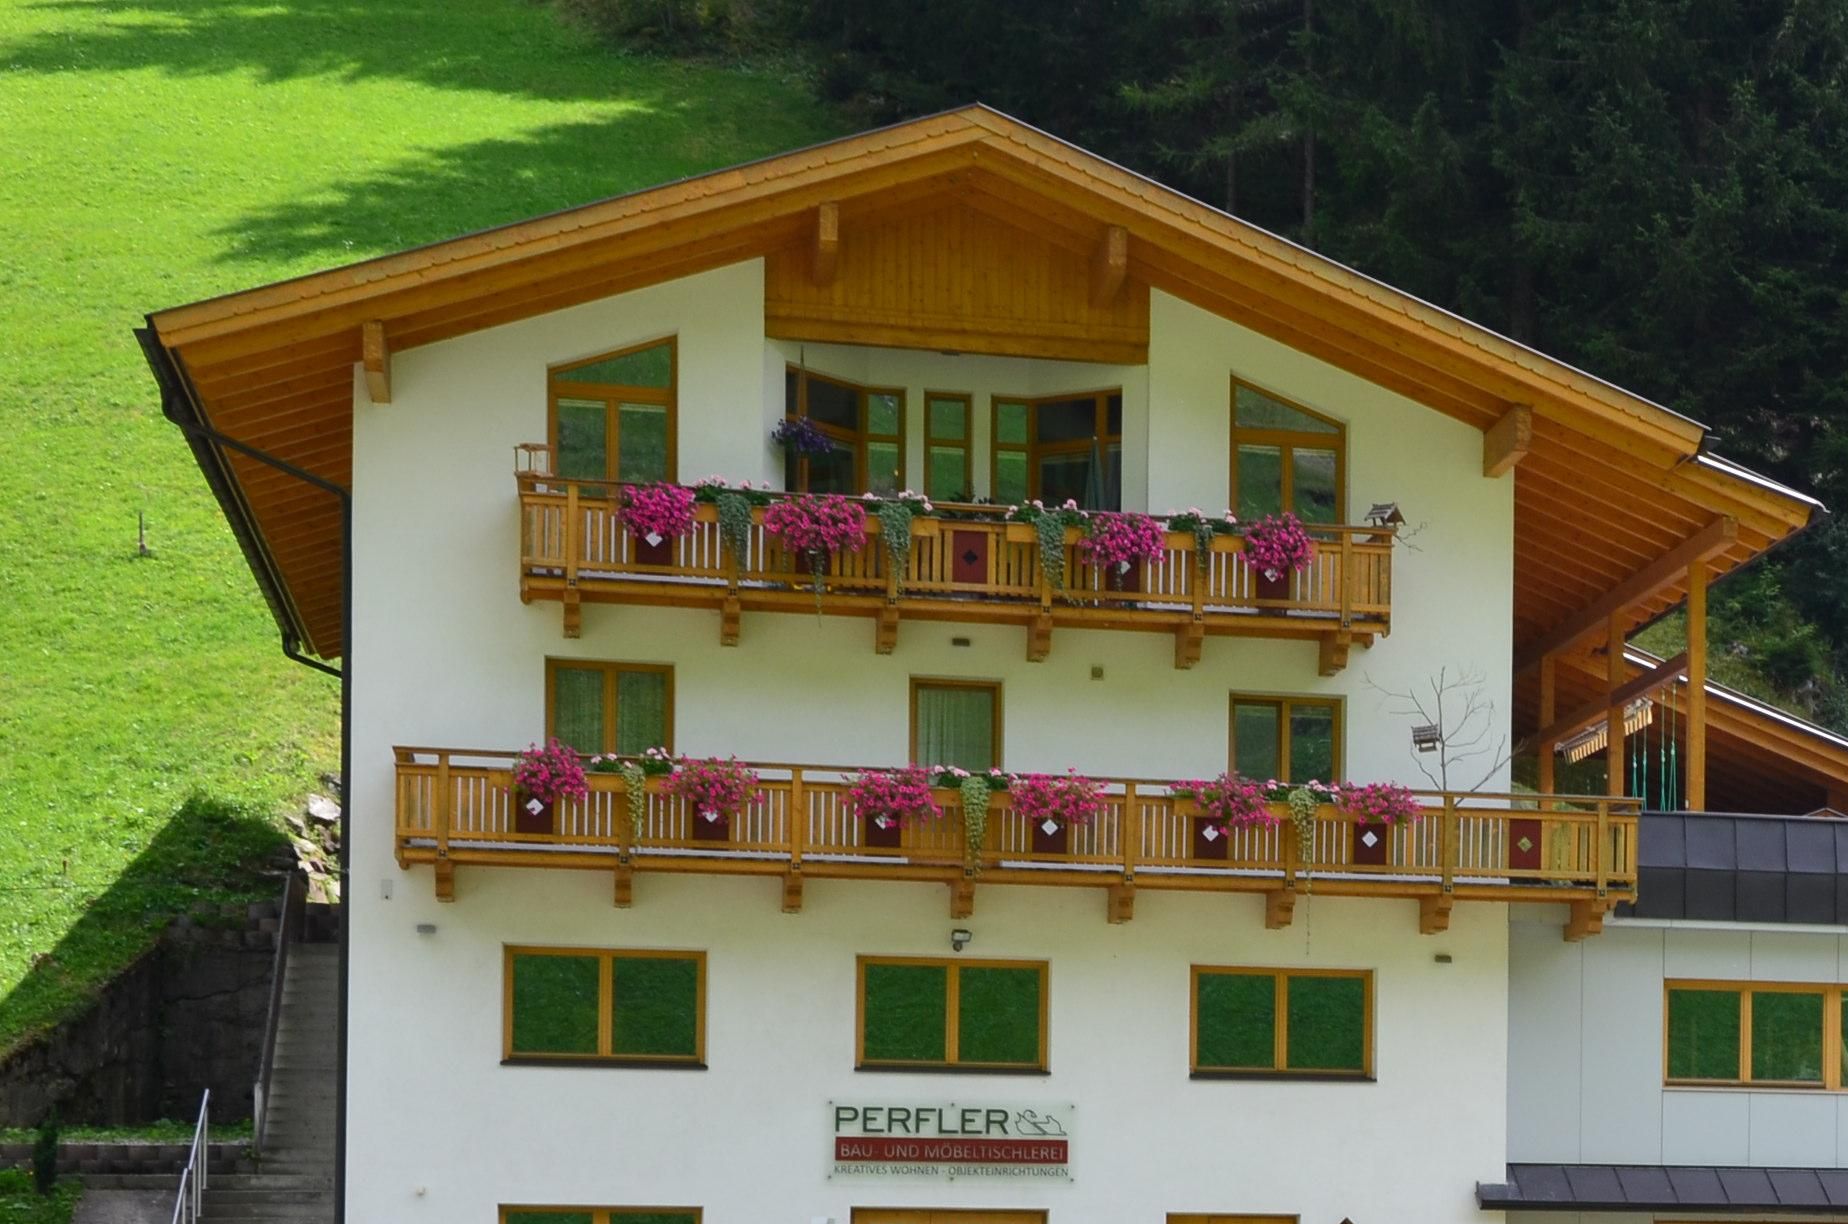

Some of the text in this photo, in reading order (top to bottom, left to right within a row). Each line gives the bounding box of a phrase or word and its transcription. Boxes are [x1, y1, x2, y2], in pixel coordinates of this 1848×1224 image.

[835, 1106, 1009, 1135] PERFLER
[884, 1145, 920, 1158] UND
[924, 1142, 1064, 1160] MÖBELTISCHLEREI
[834, 1165, 887, 1175] KREATIVES
[890, 1166, 939, 1175] WOHNEN
[948, 1166, 1069, 1177] OBJEKTEINRICHTUNGEN
